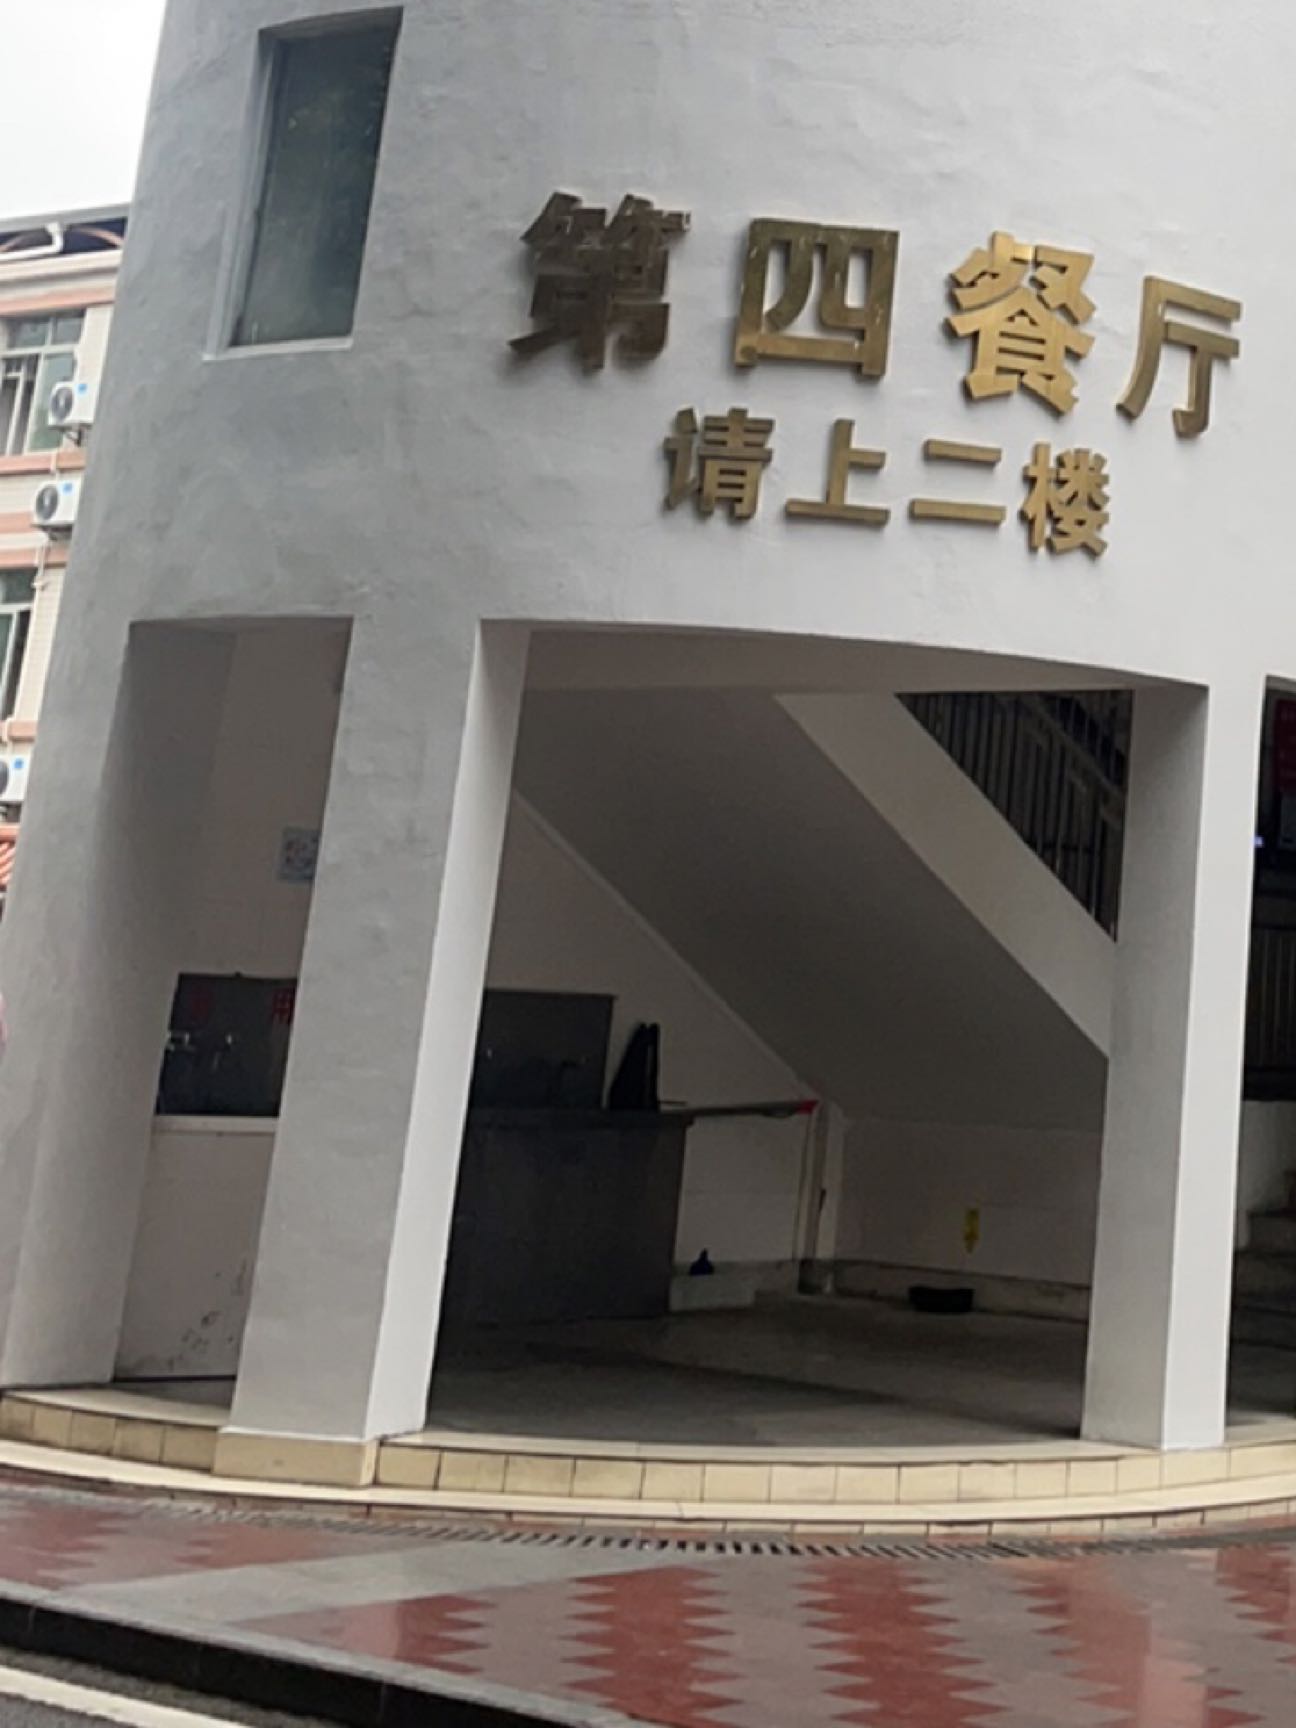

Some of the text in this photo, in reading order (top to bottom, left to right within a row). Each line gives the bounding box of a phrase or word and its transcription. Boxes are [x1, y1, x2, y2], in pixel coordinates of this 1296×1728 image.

[509, 191, 1242, 439] 第四餐厅
[662, 406, 1113, 559] 请上二楼
